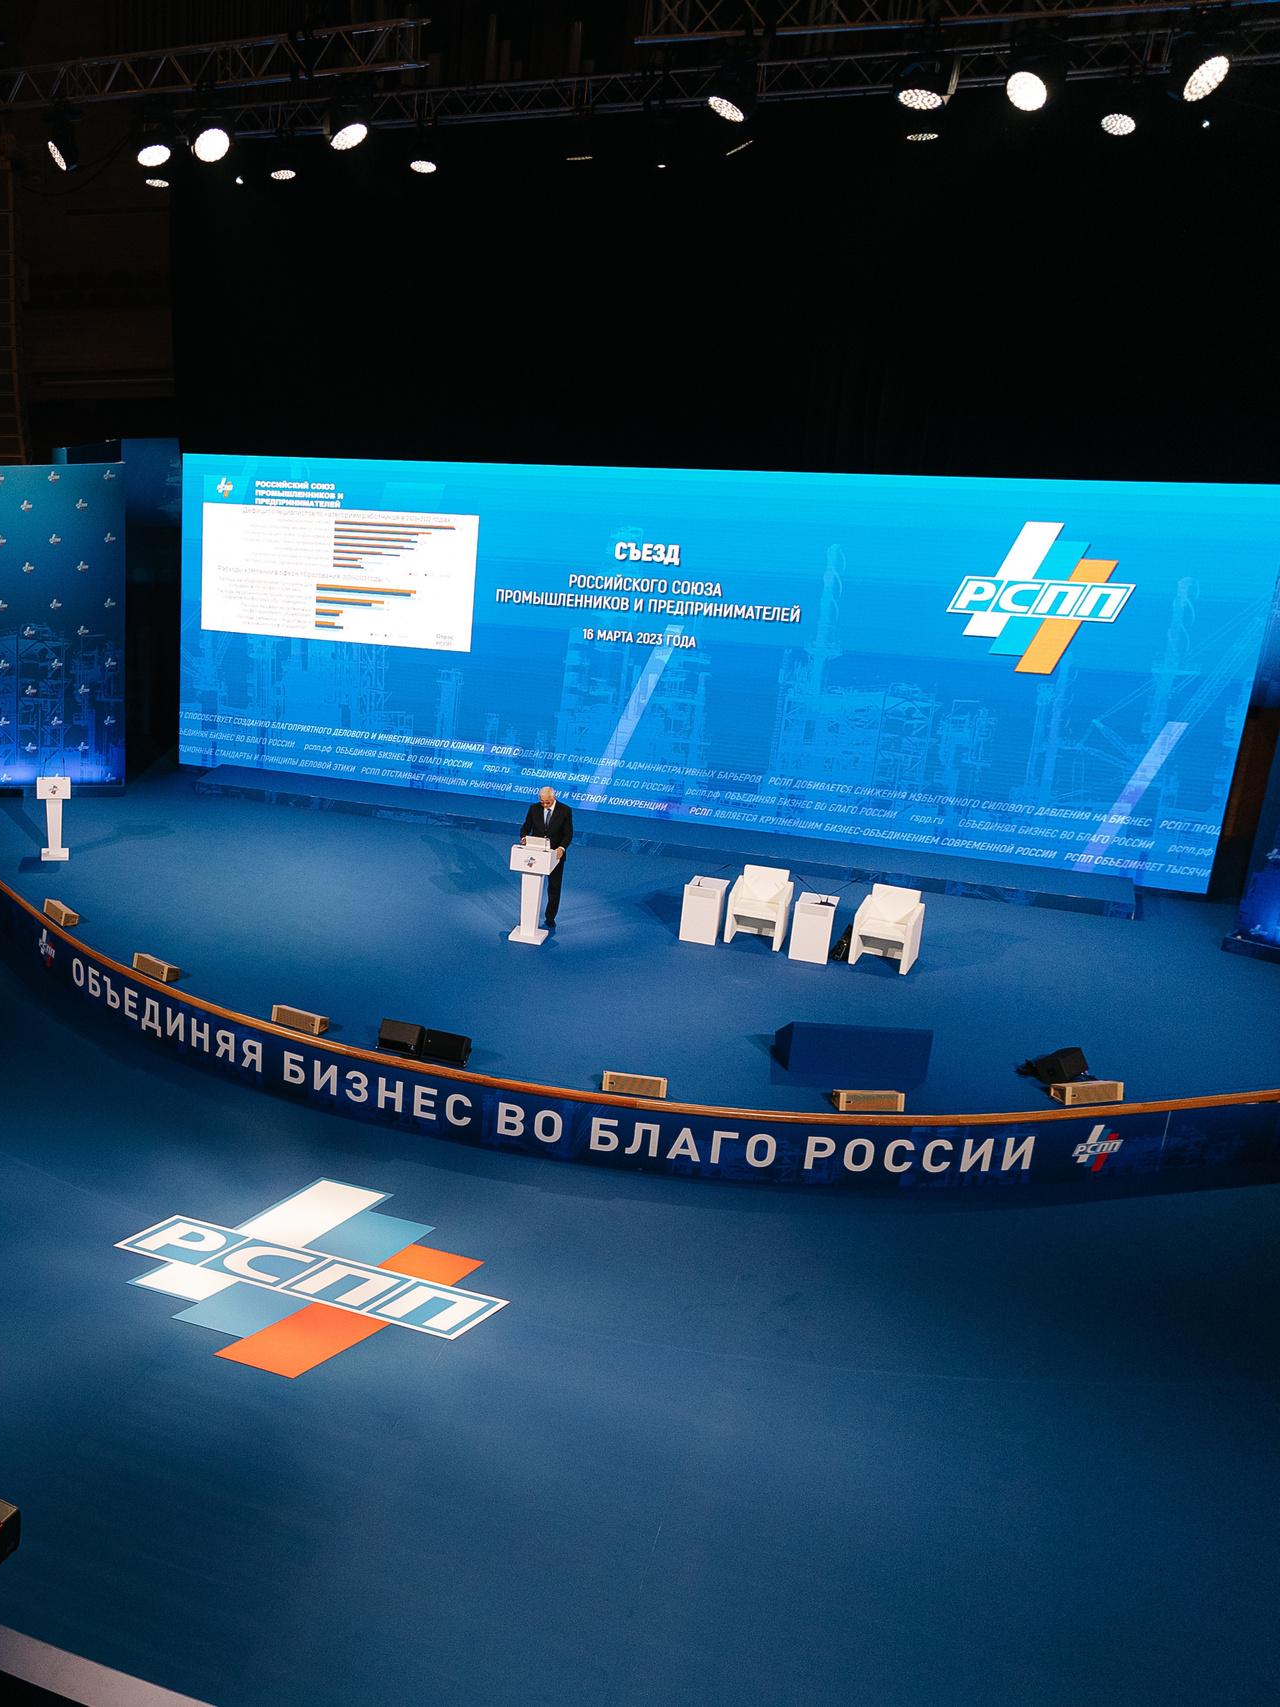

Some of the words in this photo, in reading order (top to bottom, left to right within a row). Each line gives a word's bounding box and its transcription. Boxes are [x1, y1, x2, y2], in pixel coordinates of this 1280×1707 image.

[255, 480, 309, 489] РОССИЙСКИЙ
[255, 490, 335, 499] ПРОМЫШЛЕННИКОВ
[255, 498, 340, 507] ПРЕДПРИНИМАТЕЛЕЙ
[615, 542, 680, 565] СЪЕЗД
[569, 574, 667, 593] РОССИЙСКОГО
[672, 581, 722, 597] СОЮЗА
[954, 580, 1128, 618] РСПП
[496, 589, 630, 611] ПРОМЫШЛЕННИКОВ
[634, 599, 644, 611] И
[648, 599, 801, 623] ПРЕДПРИНИМАТЕЛЕЙ
[583, 628, 594, 640] 16
[597, 630, 634, 643] МАРТА
[636, 632, 663, 645] 2023
[666, 634, 696, 648] ГОДА
[184, 712, 232, 724] СПОСОБСТВУЕТ
[233, 717, 270, 728] СОЗДАНИЮ
[271, 722, 332, 735] БЛАГОПРИЯТНОГО
[332, 729, 370, 739] ДЕЛОВОГО
[370, 732, 377, 740] И
[378, 733, 450, 748] ИНВЕСТИЦИОННОГО
[451, 741, 485, 752] КЛИМАТА
[491, 746, 512, 755] РСПП
[512, 748, 567, 761] СОДЕЙСТВУЕТ
[568, 755, 626, 767] СОКРАЩЕНИЮ
[626, 761, 716, 778] АДМИНИСТРАТИВНЫХ
[717, 772, 762, 783] БАРЬЕРОВ
[768, 777, 792, 786] РСПП
[793, 779, 853, 794] ДОБИВАЕТСЯ
[854, 787, 907, 799] СНИЖЕНИЯ
[908, 793, 980, 808] ИЗБЫТОЧНОГО
[981, 801, 1035, 813] СИЛОВОГО
[1035, 807, 1091, 820] ДАВЛЕНИЯ
[1092, 813, 1107, 822] НА
[1108, 815, 1152, 827] БИЗНЕС
[1159, 820, 1191, 830] РСПП
[209, 731, 235, 740] БИЗНЕС
[246, 736, 267, 744] БЛАГО
[268, 738, 295, 748] РОССИИ
[304, 743, 332, 754] рспп.рф
[335, 746, 377, 758] ОБЪЕДИНЯЯ
[378, 751, 406, 761] БИЗНЕС
[407, 754, 417, 762] ВО
[419, 755, 442, 765] БЛАГО
[442, 758, 473, 768] РОССИИ
[483, 765, 510, 773] rspp.ru
[521, 768, 567, 781] ОБЪЕДИНЯЯ
[568, 773, 600, 784] БИЗНЕС
[601, 777, 612, 785] ВО
[614, 778, 640, 788] БЛАГО
[642, 782, 675, 792] РОССИИ
[685, 788, 721, 799] рспп.рф
[724, 791, 776, 805] ОБЪЕДИНЯЯ
[777, 798, 813, 809] БИЗНЕС
[814, 802, 827, 811] ВО
[828, 804, 858, 815] БЛАГО
[859, 808, 898, 818] РОССИИ
[910, 814, 945, 824] rspp.ru
[958, 818, 1017, 832] ОБЪЕДИНЯЯ
[1019, 826, 1057, 838] БИЗНЕС
[1060, 831, 1074, 839] ВО
[1076, 832, 1110, 844] БЛАГО
[1111, 837, 1155, 849] РОССИИ
[1168, 844, 1213, 857] рспп.рф
[215, 749, 252, 760] СТАНДАРТЫ
[260, 755, 298, 766] ПРИНЦИПЫ
[299, 759, 332, 770] ДЕЛОВОЙ
[332, 764, 356, 772] ЭТИКИ
[361, 767, 380, 775] РСПП
[381, 769, 425, 781] ОТСТАИВАЕТ
[426, 776, 468, 786] ПРИНЦИПЫ
[469, 780, 512, 792] РЫНОЧНОЙ
[513, 785, 562, 798] ЭКОНОИ
[572, 792, 608, 803] ЧЕСТНОЙ
[608, 797, 668, 811] КОНКУРЕНЦИИ
[689, 807, 712, 816] РСПП
[714, 811, 758, 822] ЯВЛЯЕТСЯ
[759, 815, 822, 830] КРУПНЕЙШИМ
[824, 823, 940, 845] БИЗНЕС-ОБЪЕДИНЕНИЕМ
[941, 838, 1014, 853] СОВРЕМЕННОЙ
[1015, 847, 1058, 859] РОССИИ
[1064, 852, 1094, 863] РСПП
[1094, 856, 1165, 872] ОБЪЕДИНЯЕТ
[1165, 864, 1212, 878] ТЫСЯЧИ
[72, 958, 262, 1072] ОБЪЕДИНЯЯ
[283, 1050, 472, 1126] БИЗНЕС
[496, 1102, 563, 1143] ВО
[590, 1116, 776, 1168] БЛАГО
[803, 1136, 1036, 1172] РОССИИ
[1075, 1140, 1123, 1156] РСПП
[132, 1221, 491, 1333] РСПП
